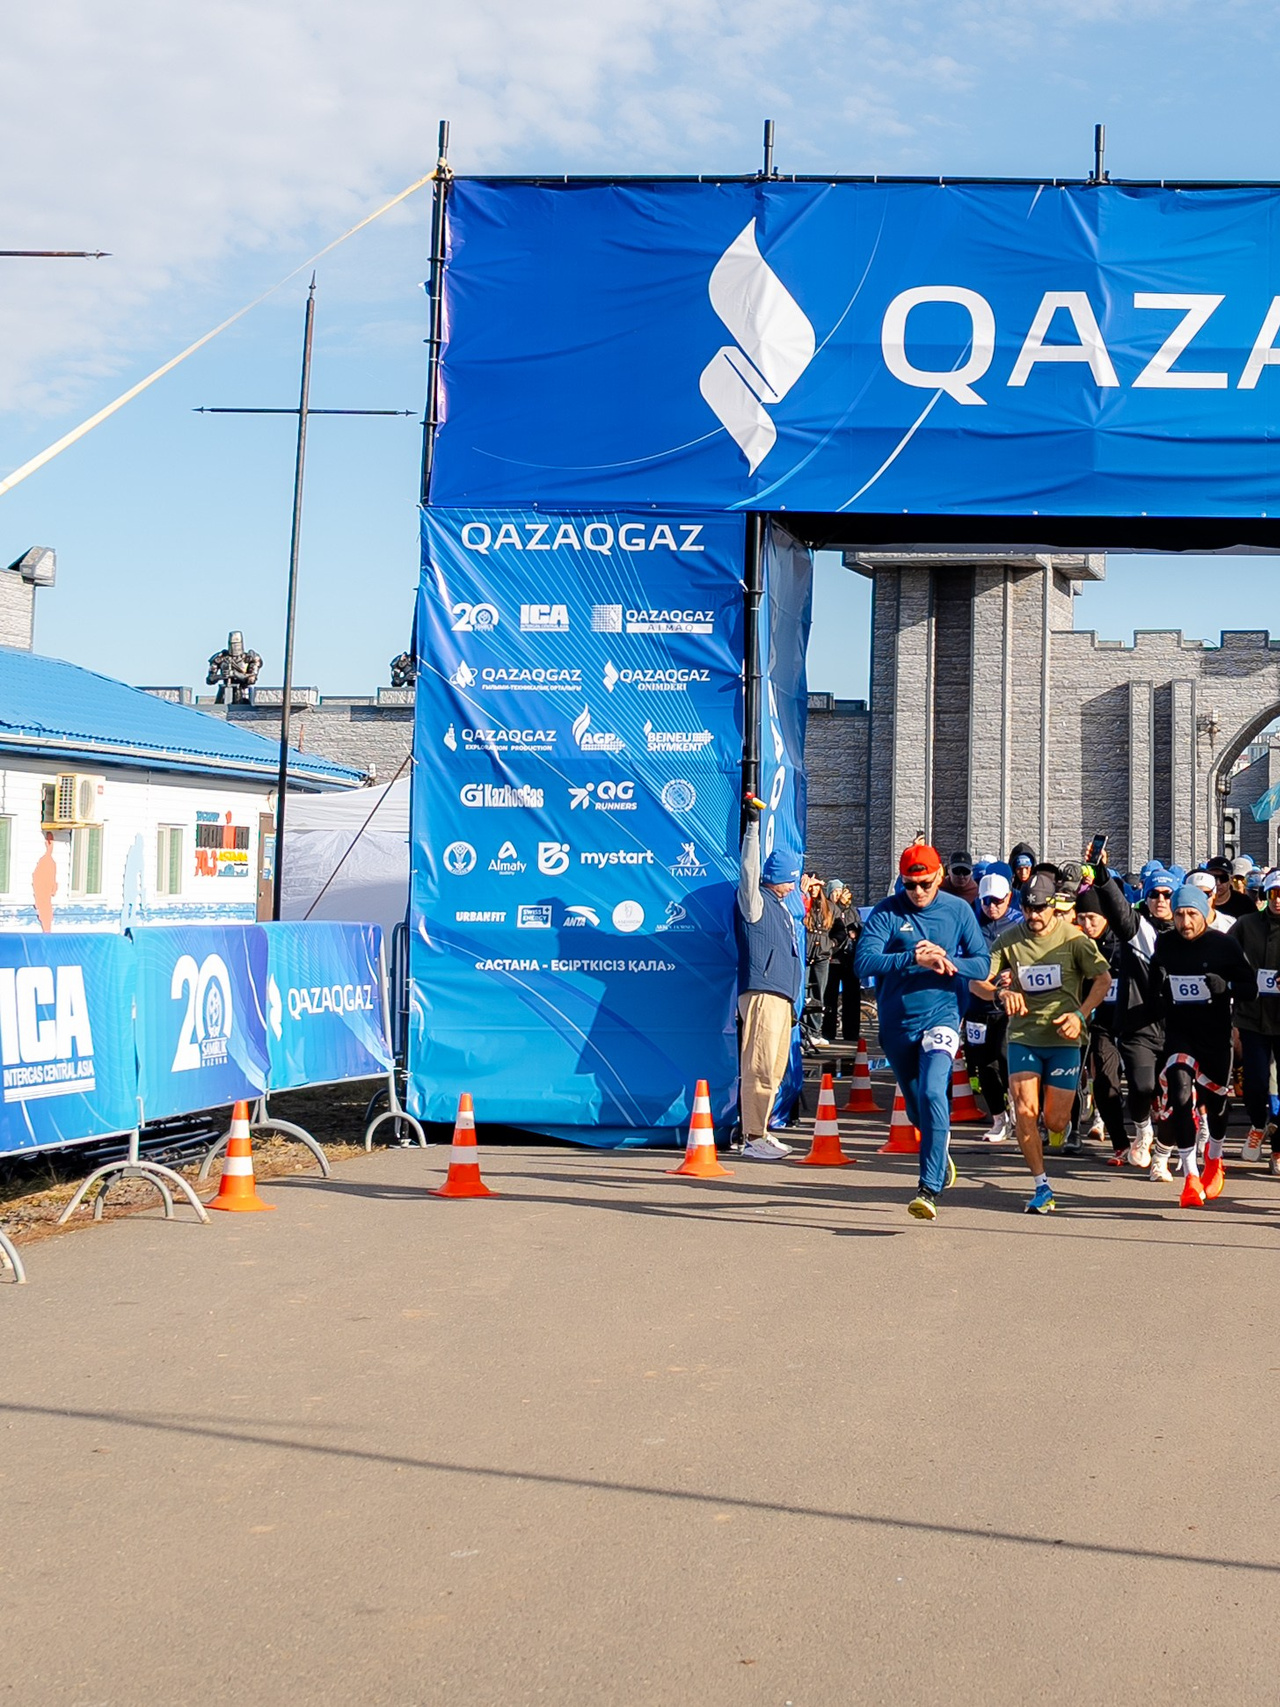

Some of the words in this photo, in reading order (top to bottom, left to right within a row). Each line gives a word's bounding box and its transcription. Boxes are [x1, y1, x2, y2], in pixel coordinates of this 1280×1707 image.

[461, 522, 705, 555] QAZAQGAZ
[451, 602, 499, 632] 20
[520, 604, 569, 625] ICA
[626, 609, 715, 623] QAZAQGAZ
[482, 668, 582, 682] QAZAQGAZ
[620, 668, 711, 683] QAZAQGAZ
[461, 729, 557, 743] QAZAQGAZ
[581, 733, 615, 744] AGP
[647, 733, 692, 743] BEINEU
[647, 743, 703, 751] SHYMKENT
[484, 784, 544, 808] KazRosGas
[597, 781, 635, 800] QG
[595, 802, 637, 810] RUNNERS
[488, 859, 527, 873] Almaty
[580, 850, 654, 869] mystart
[669, 868, 707, 877] TANZA
[456, 911, 507, 923] URBANFIT
[563, 917, 586, 927] ANTA
[475, 959, 540, 971] «АСТАНА
[551, 959, 626, 972] ЕСІРТКІСІЗ
[628, 960, 676, 975] ҚАЛА»
[1027, 973, 1053, 987] 161
[1179, 983, 1200, 996] 68
[288, 984, 374, 1020] QAZAQGAZ
[0, 965, 94, 1066] ICA
[171, 953, 232, 1073] 20
[934, 1033, 953, 1047] 32
[968, 1028, 981, 1040] 59
[43, 1061, 77, 1082] CENTRAL
[77, 1059, 95, 1077] ASIA
